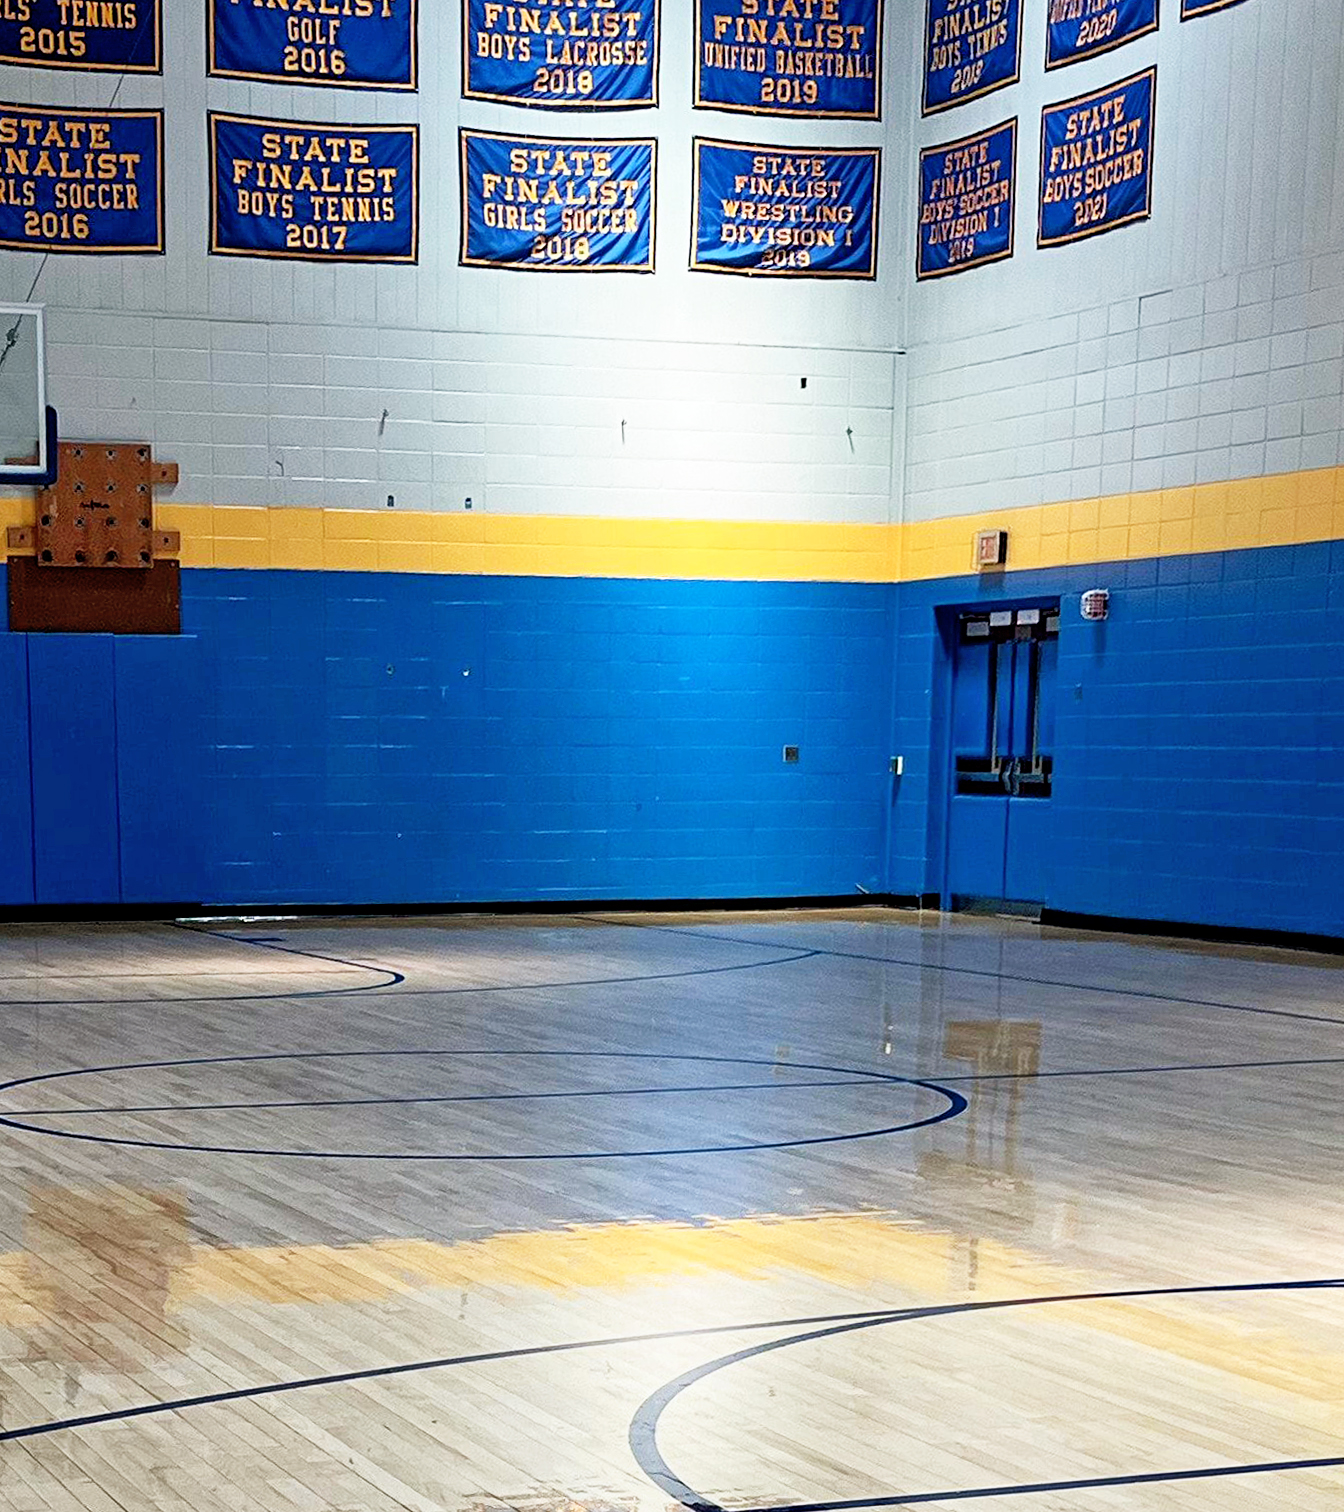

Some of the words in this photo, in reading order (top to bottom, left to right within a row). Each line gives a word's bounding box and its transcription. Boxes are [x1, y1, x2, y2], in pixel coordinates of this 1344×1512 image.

[57, 1, 137, 29] TENNIS
[230, 0, 395, 17] ALIST
[484, 3, 641, 37] FINALIST
[742, 0, 839, 20] STATE
[20, 26, 86, 56] 2015
[286, 16, 341, 45] GOLF
[714, 15, 865, 50] FINALIST
[1076, 8, 1117, 46] 2020
[284, 45, 346, 75] 2016
[477, 32, 530, 62] BOYS
[546, 39, 647, 66] LACROSSE
[705, 42, 766, 72] UNIFIED
[776, 50, 873, 78] BASKETBALL
[930, 40, 960, 72] BOYS
[533, 67, 593, 94] 2018
[761, 78, 817, 103] 2019
[1066, 94, 1125, 140] STATE
[262, 133, 369, 163] STATE
[944, 142, 988, 174] STATE
[1050, 118, 1141, 172] FINALIST
[233, 159, 397, 193] FINALIST
[510, 149, 612, 177] STATE
[753, 156, 827, 177] STATE
[1044, 171, 1082, 203] BOYS
[1085, 149, 1144, 194] SOCCER
[482, 174, 638, 205] FINALIST
[735, 175, 841, 198] FINALIST
[930, 160, 1001, 199] FINALIST
[55, 182, 138, 209] SOCCER
[237, 189, 293, 218] BOYS
[310, 196, 395, 221] TENNIS
[959, 180, 1008, 215] SOCCER
[1074, 193, 1107, 226] 2021
[24, 210, 89, 239] 2016
[484, 203, 546, 231] GIRLS
[561, 208, 638, 233] SOCCER
[721, 199, 854, 223] WRESTLING
[286, 224, 347, 249] 2017
[721, 224, 834, 246] DIVISION
[928, 210, 988, 244] DIVISION
[531, 235, 590, 261] 2018
[762, 250, 810, 267] 2019
